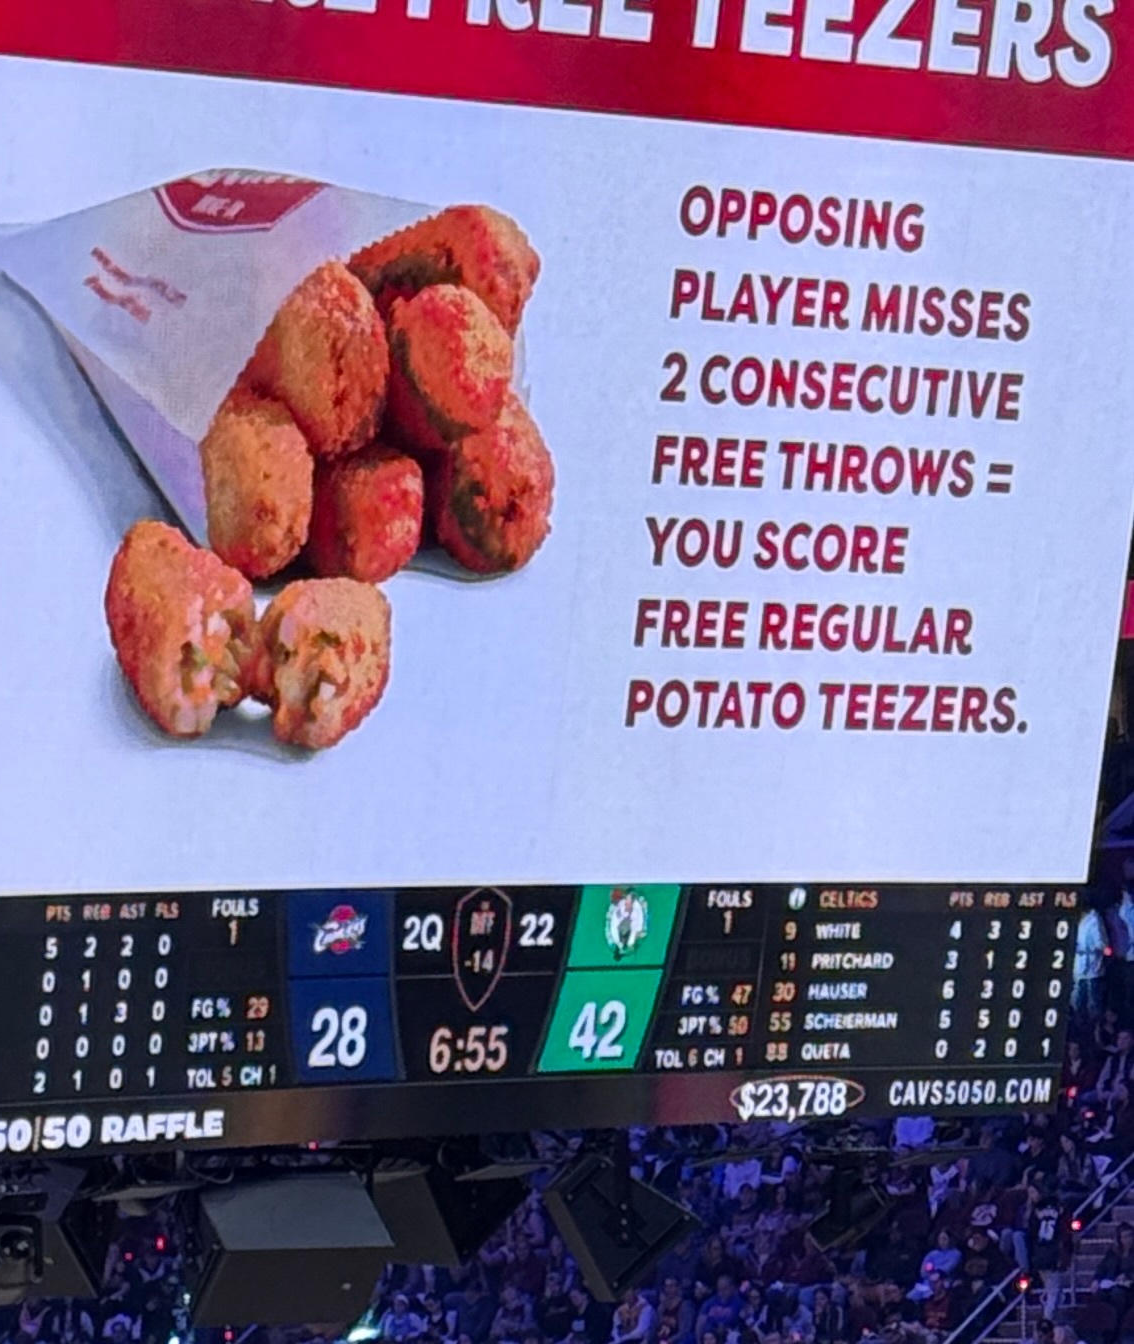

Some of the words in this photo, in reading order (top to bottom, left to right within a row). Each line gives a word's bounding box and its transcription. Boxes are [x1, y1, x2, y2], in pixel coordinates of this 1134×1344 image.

[679, 185, 925, 253] OPPOSING
[671, 270, 850, 332] PLAYER
[860, 286, 1033, 343] MISSES
[660, 353, 689, 404] 2
[699, 356, 1023, 422] CONSECUTIVE
[653, 436, 774, 491] FREE
[780, 443, 978, 498] THROWS
[646, 517, 744, 571] YOU
[754, 520, 910, 576] SCORE
[634, 600, 747, 650] FREE
[759, 603, 975, 655] REGULAR
[626, 681, 807, 732] POTATO
[814, 683, 1028, 735] TEEZERS.
[212, 899, 259, 917] FOULS
[708, 890, 753, 908] FOULS
[819, 890, 878, 908] CELTICS
[84, 936, 97, 957] 2
[122, 935, 133, 955] 2
[158, 935, 170, 955] 0
[402, 914, 444, 952] 2Q
[520, 914, 555, 947] 22
[816, 922, 861, 939] WHITE
[949, 920, 962, 939] 4
[1057, 920, 1067, 940] 0
[811, 952, 893, 971] PRITCHARD
[773, 983, 795, 1002] 30
[808, 982, 867, 1000] HAUSER
[308, 1005, 368, 1069] 28
[569, 999, 627, 1060] 42
[804, 1012, 897, 1031] SCHEIERMAN
[428, 1025, 509, 1074] 6:55
[704, 1049, 724, 1067] CH
[801, 1042, 850, 1061] QUETA
[240, 1066, 262, 1085] CH
[739, 1081, 846, 1122] $23,788
[889, 1078, 1051, 1108] CAVS5050.COM
[101, 1110, 224, 1143] RAFFLE
